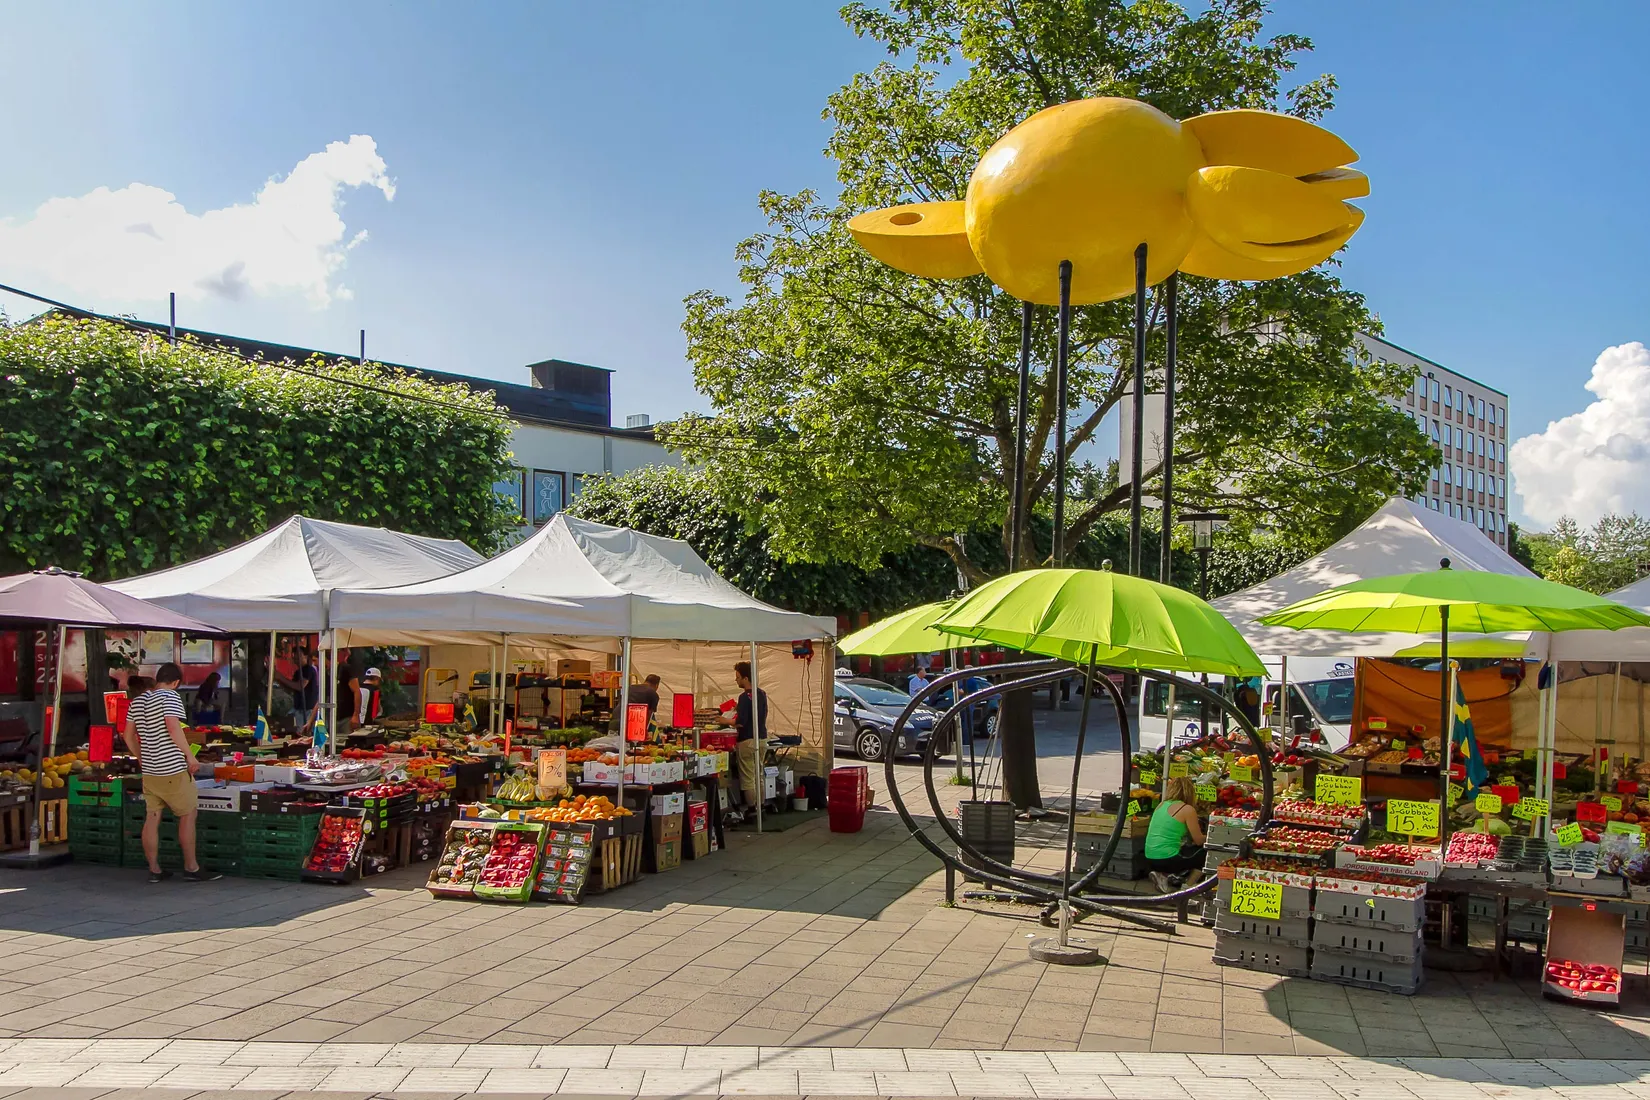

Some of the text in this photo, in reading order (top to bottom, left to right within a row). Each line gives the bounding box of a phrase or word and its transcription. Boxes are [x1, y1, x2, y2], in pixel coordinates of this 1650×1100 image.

[1342, 862, 1429, 877] JORDGUBBAR från ÖLAND
